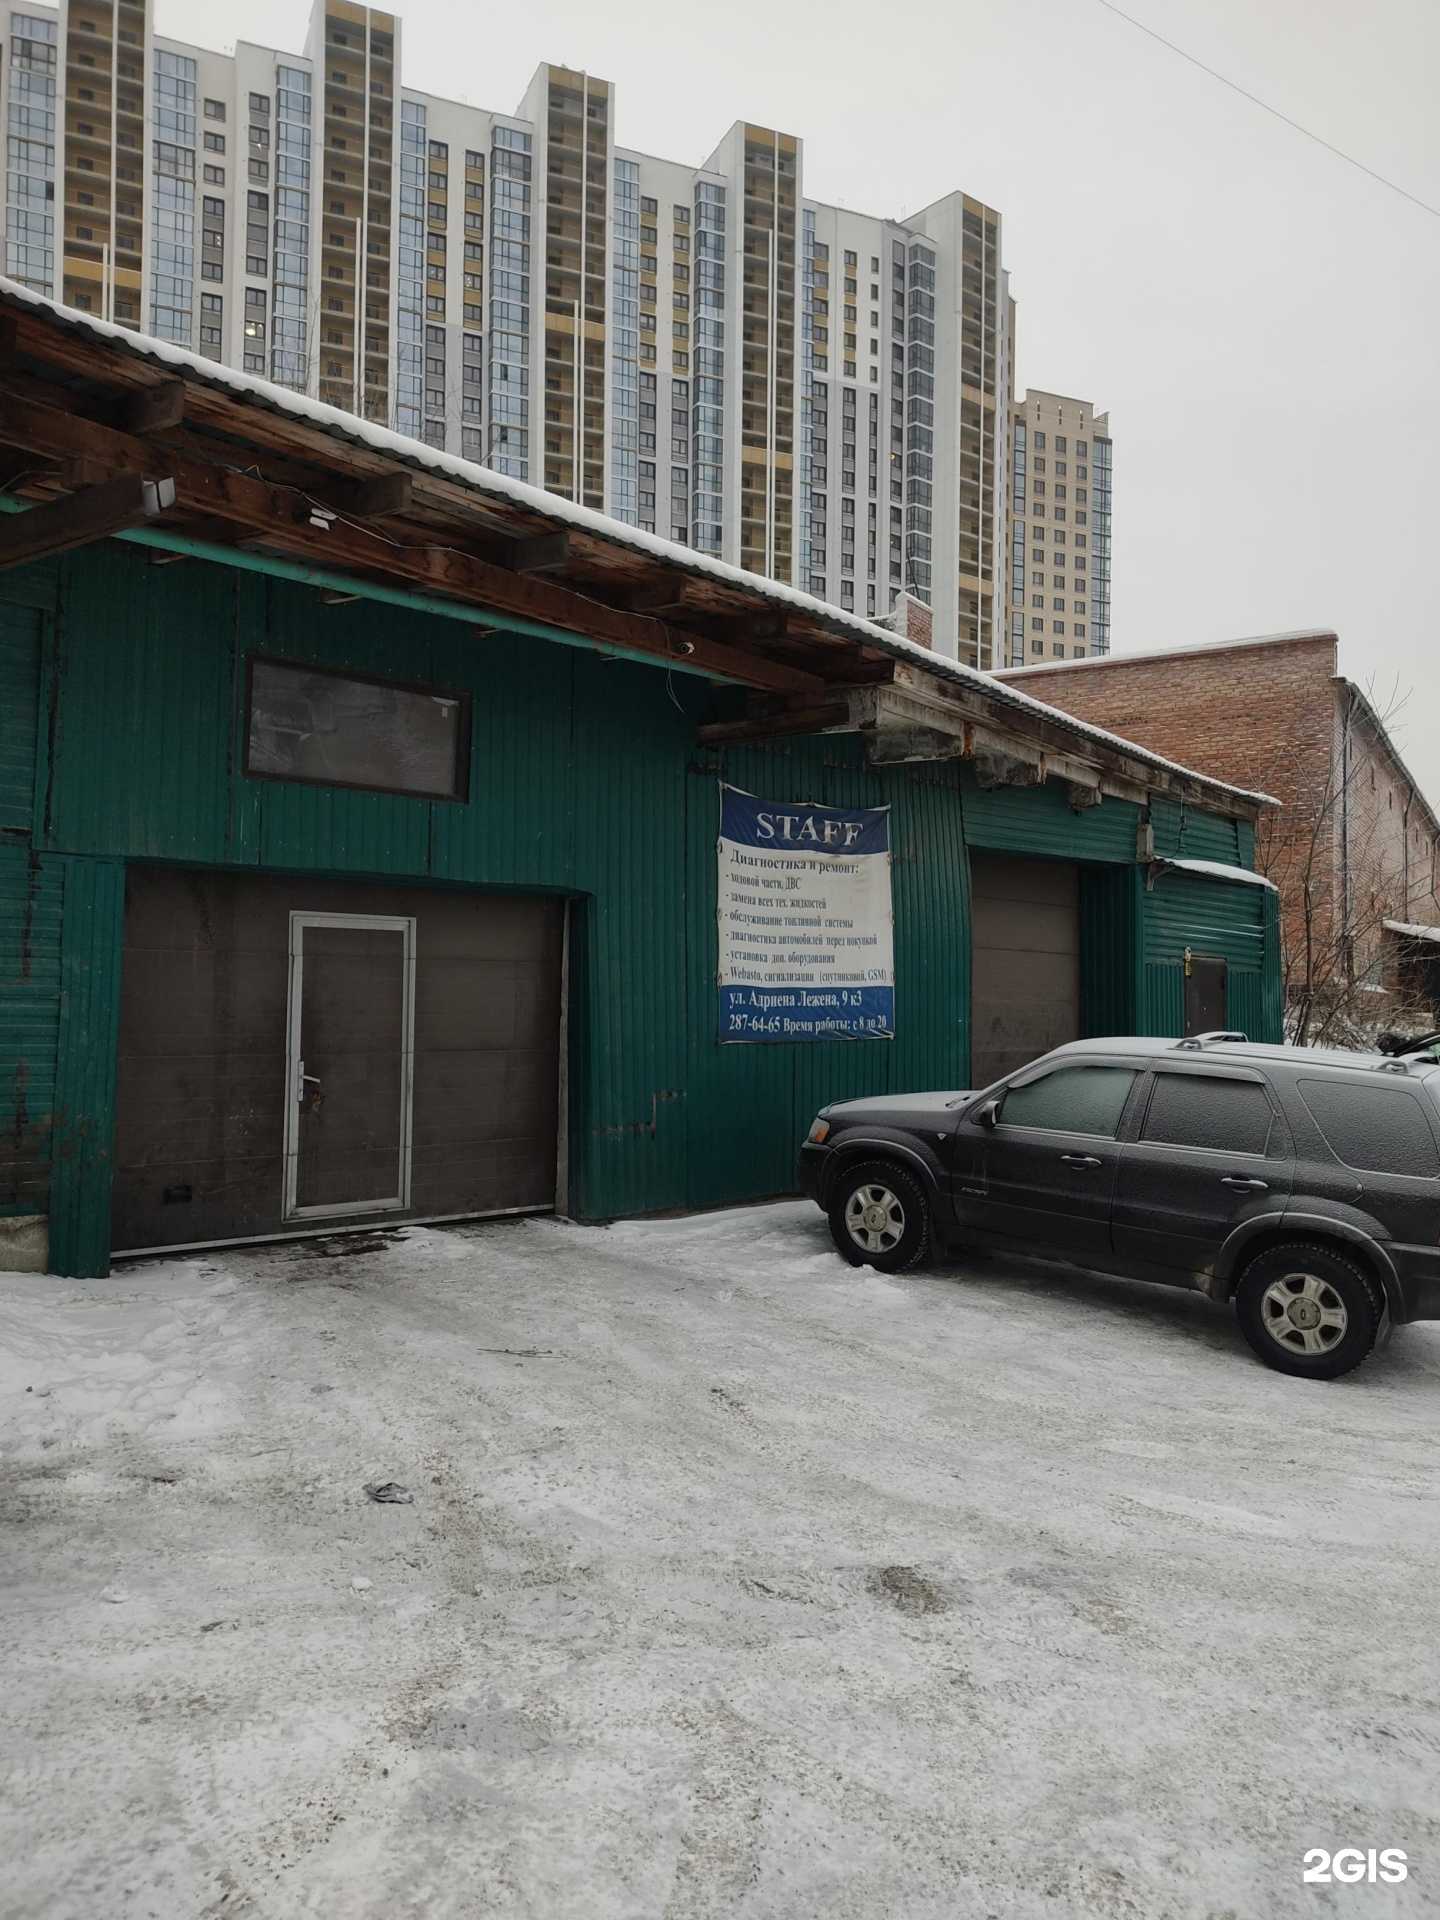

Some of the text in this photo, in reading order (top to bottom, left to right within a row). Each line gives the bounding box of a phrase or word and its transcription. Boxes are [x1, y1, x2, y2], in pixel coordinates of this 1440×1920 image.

[756, 812, 864, 847] STAFF
[730, 849, 859, 875] Диагностика и ремонт:
[785, 876, 801, 890] ДВС
[731, 892, 756, 906] замена
[758, 896, 774, 907] всех
[789, 897, 827, 910] жидкостей
[729, 909, 853, 929] обслуживание топливной системы
[729, 930, 878, 949] диагностика автомобилей перед покупкой
[729, 950, 768, 963] установка
[787, 951, 836, 966] оборудования
[730, 966, 763, 982] Webasto,
[729, 990, 862, 1012] ул. Адриена Лежена, 9 к3
[729, 1014, 781, 1033] 287-64-65
[783, 1018, 813, 1035] Время
[815, 1017, 851, 1035] работы:
[852, 1020, 857, 1031] с
[859, 1015, 864, 1029] 8
[877, 1014, 887, 1029] 20
